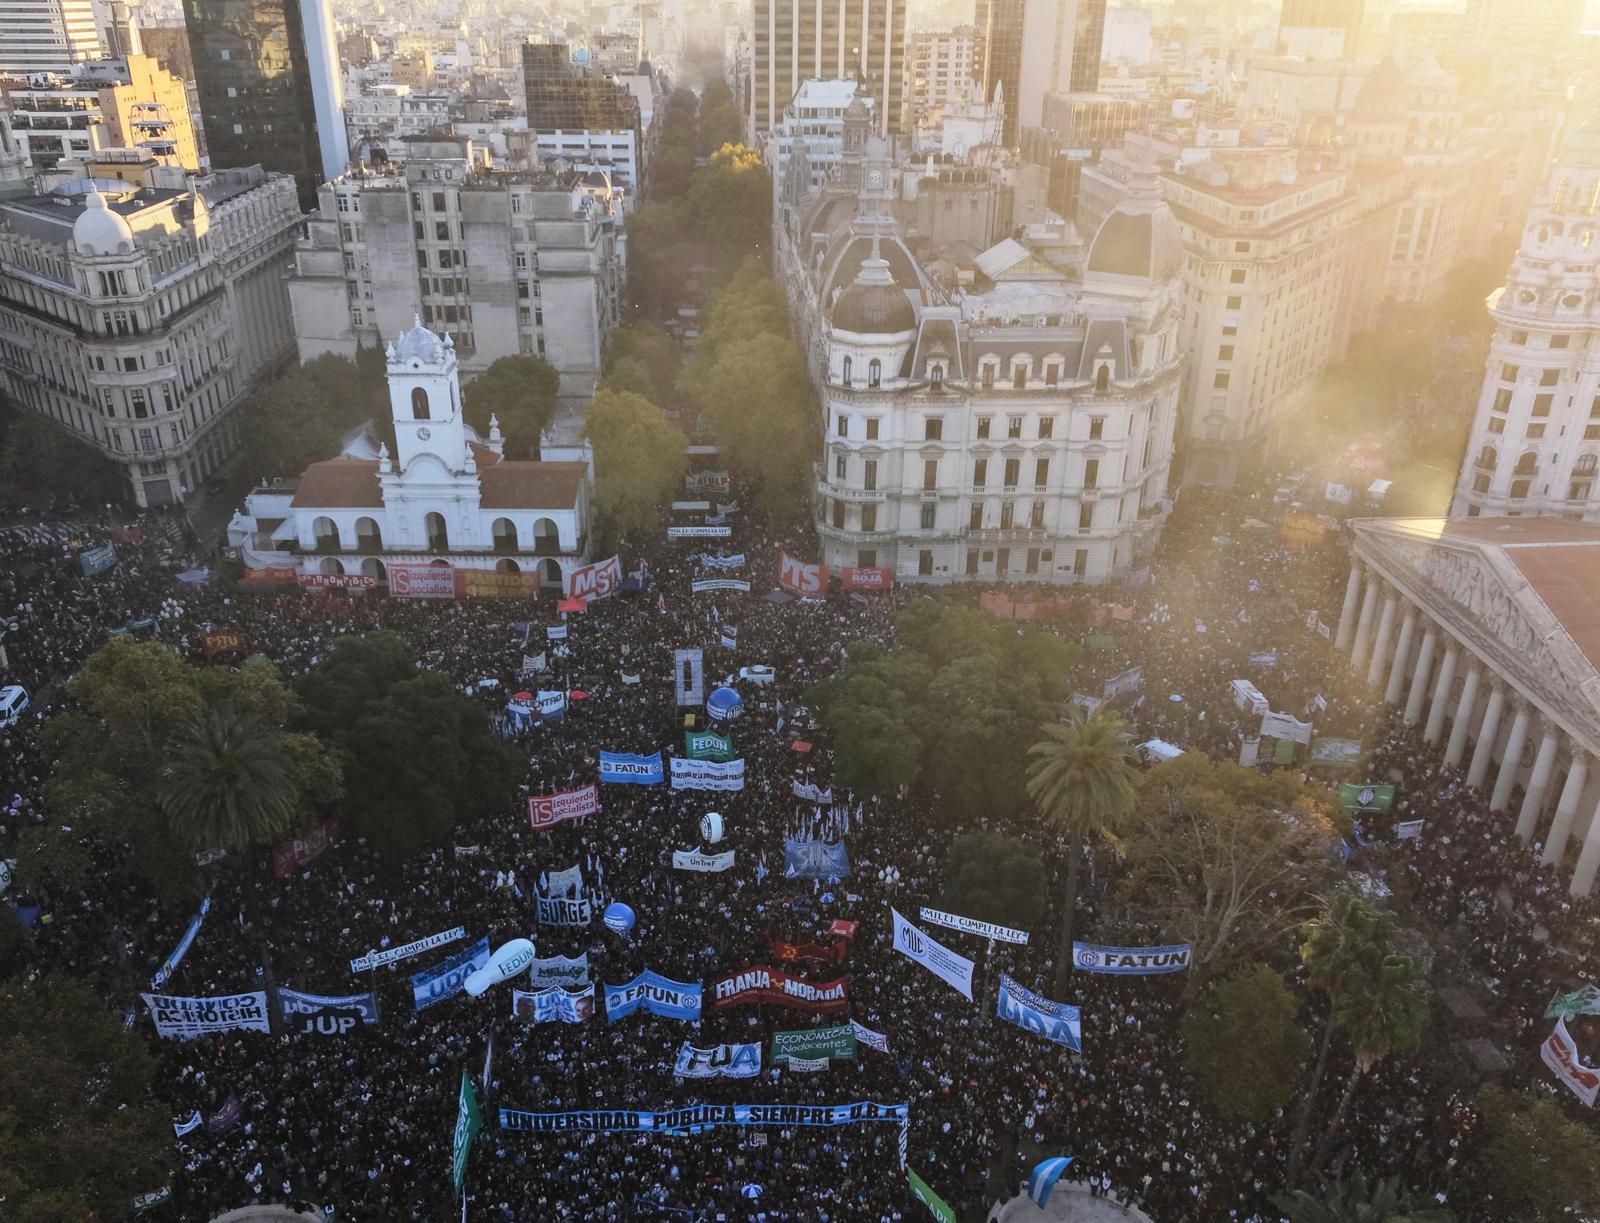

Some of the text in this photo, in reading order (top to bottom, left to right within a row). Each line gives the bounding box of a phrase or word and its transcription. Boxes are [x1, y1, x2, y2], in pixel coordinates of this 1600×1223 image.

[409, 569, 452, 584] izquierda
[464, 573, 534, 586] PARTIDO
[781, 553, 820, 592] PTS
[852, 574, 883, 582] ROJA
[409, 584, 453, 594] socialista
[693, 737, 728, 751] FEDUN
[615, 764, 649, 775] FATUN
[553, 791, 594, 809] izquierda
[553, 801, 595, 817] socialista
[541, 900, 588, 923] SURGE
[498, 948, 534, 975] FEDUN
[1104, 951, 1188, 967] FATUN
[625, 984, 679, 1005] FATUN
[716, 970, 771, 999] FRANJA
[783, 979, 845, 1001] MORADA
[1000, 990, 1080, 1051] UDA
[686, 1045, 760, 1070] FUA
[505, 1110, 640, 1130] UNIVERSIDAD
[749, 1106, 835, 1124] SIEMPRE
